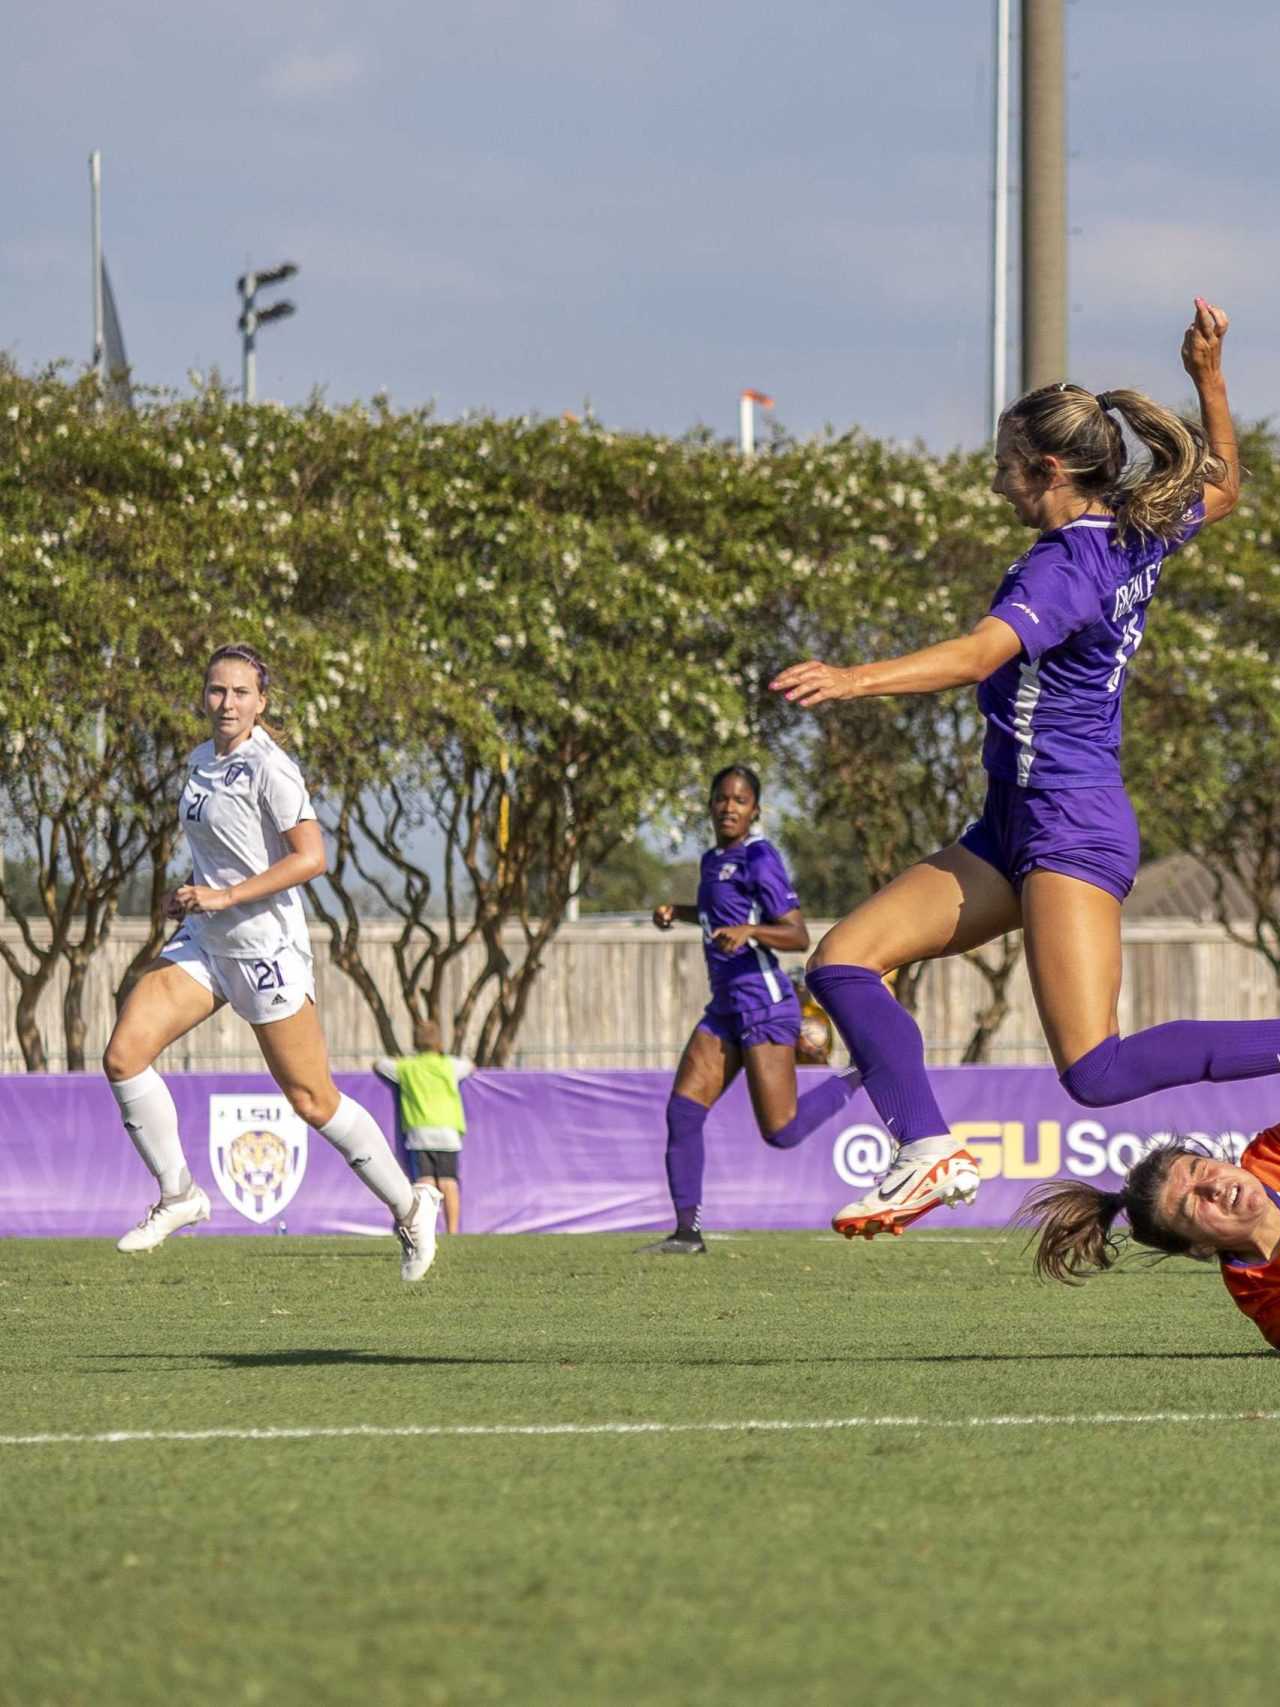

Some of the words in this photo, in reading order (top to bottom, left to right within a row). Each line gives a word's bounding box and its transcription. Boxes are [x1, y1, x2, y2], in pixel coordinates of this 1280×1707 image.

[186, 793, 208, 822] 21
[255, 960, 285, 990] 21
[236, 1107, 281, 1122] LSU
